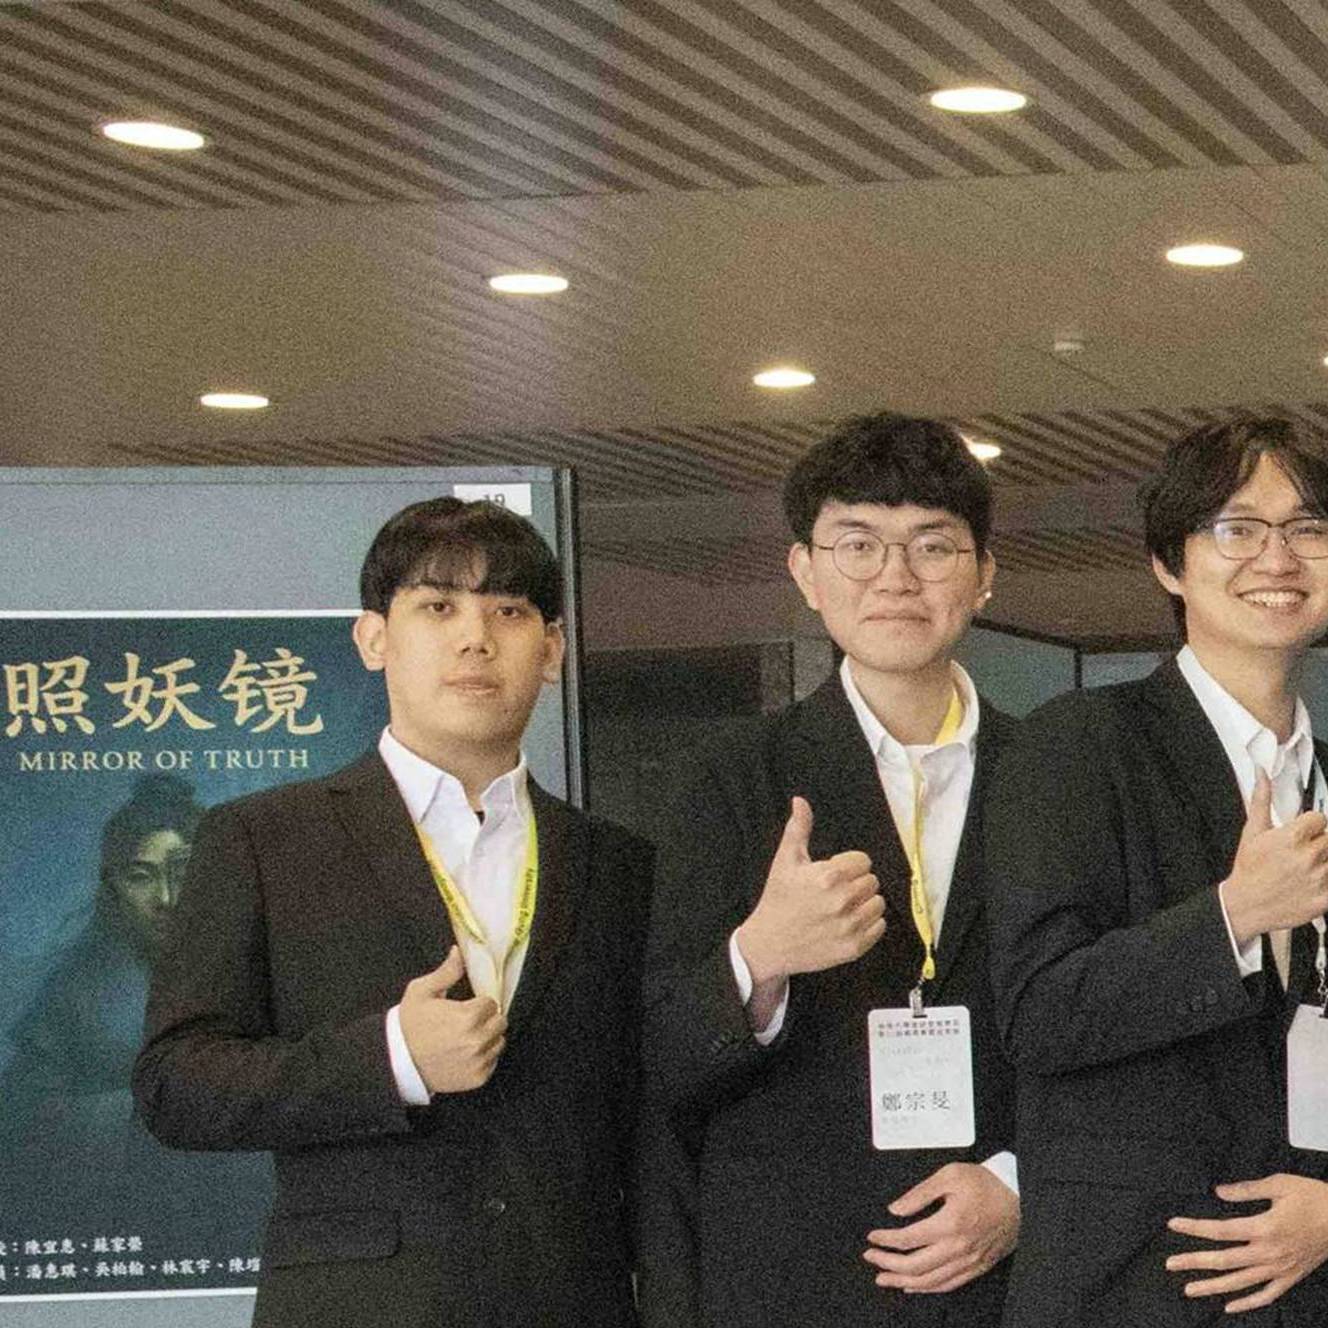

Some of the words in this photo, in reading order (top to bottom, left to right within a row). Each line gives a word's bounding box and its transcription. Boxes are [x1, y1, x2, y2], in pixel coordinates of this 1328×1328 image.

[4, 648, 324, 736] 照妖镜
[19, 752, 145, 773] MIRROR
[156, 750, 197, 771] OF
[206, 747, 310, 770] TRUTH
